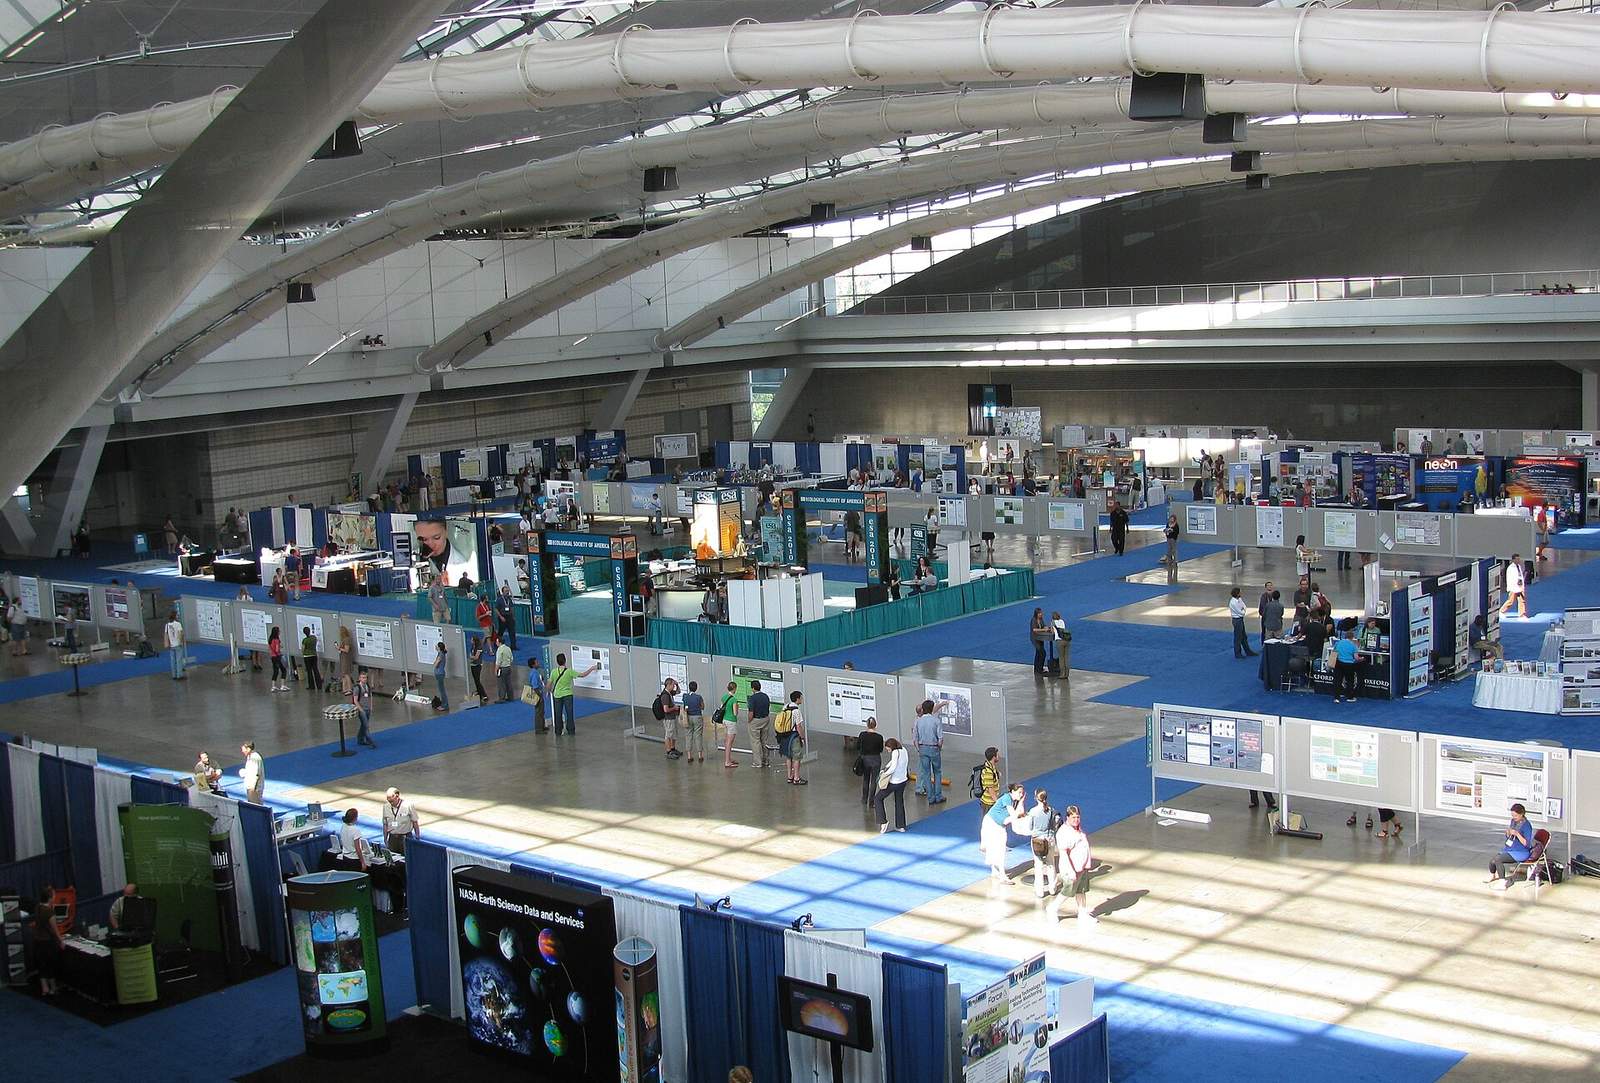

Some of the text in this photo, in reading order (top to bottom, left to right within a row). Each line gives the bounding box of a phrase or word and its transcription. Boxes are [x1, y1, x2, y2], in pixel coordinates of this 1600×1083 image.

[1424, 459, 1458, 470] neon
[697, 491, 714, 502] esa
[721, 490, 738, 502] esa
[787, 536, 795, 561] 2010
[1364, 678, 1390, 687] OXFORD
[459, 887, 478, 903] NASA
[478, 893, 497, 907] Earth
[497, 897, 523, 914] Science
[524, 904, 540, 918] Data
[540, 910, 554, 922] and
[554, 912, 585, 929] Services
